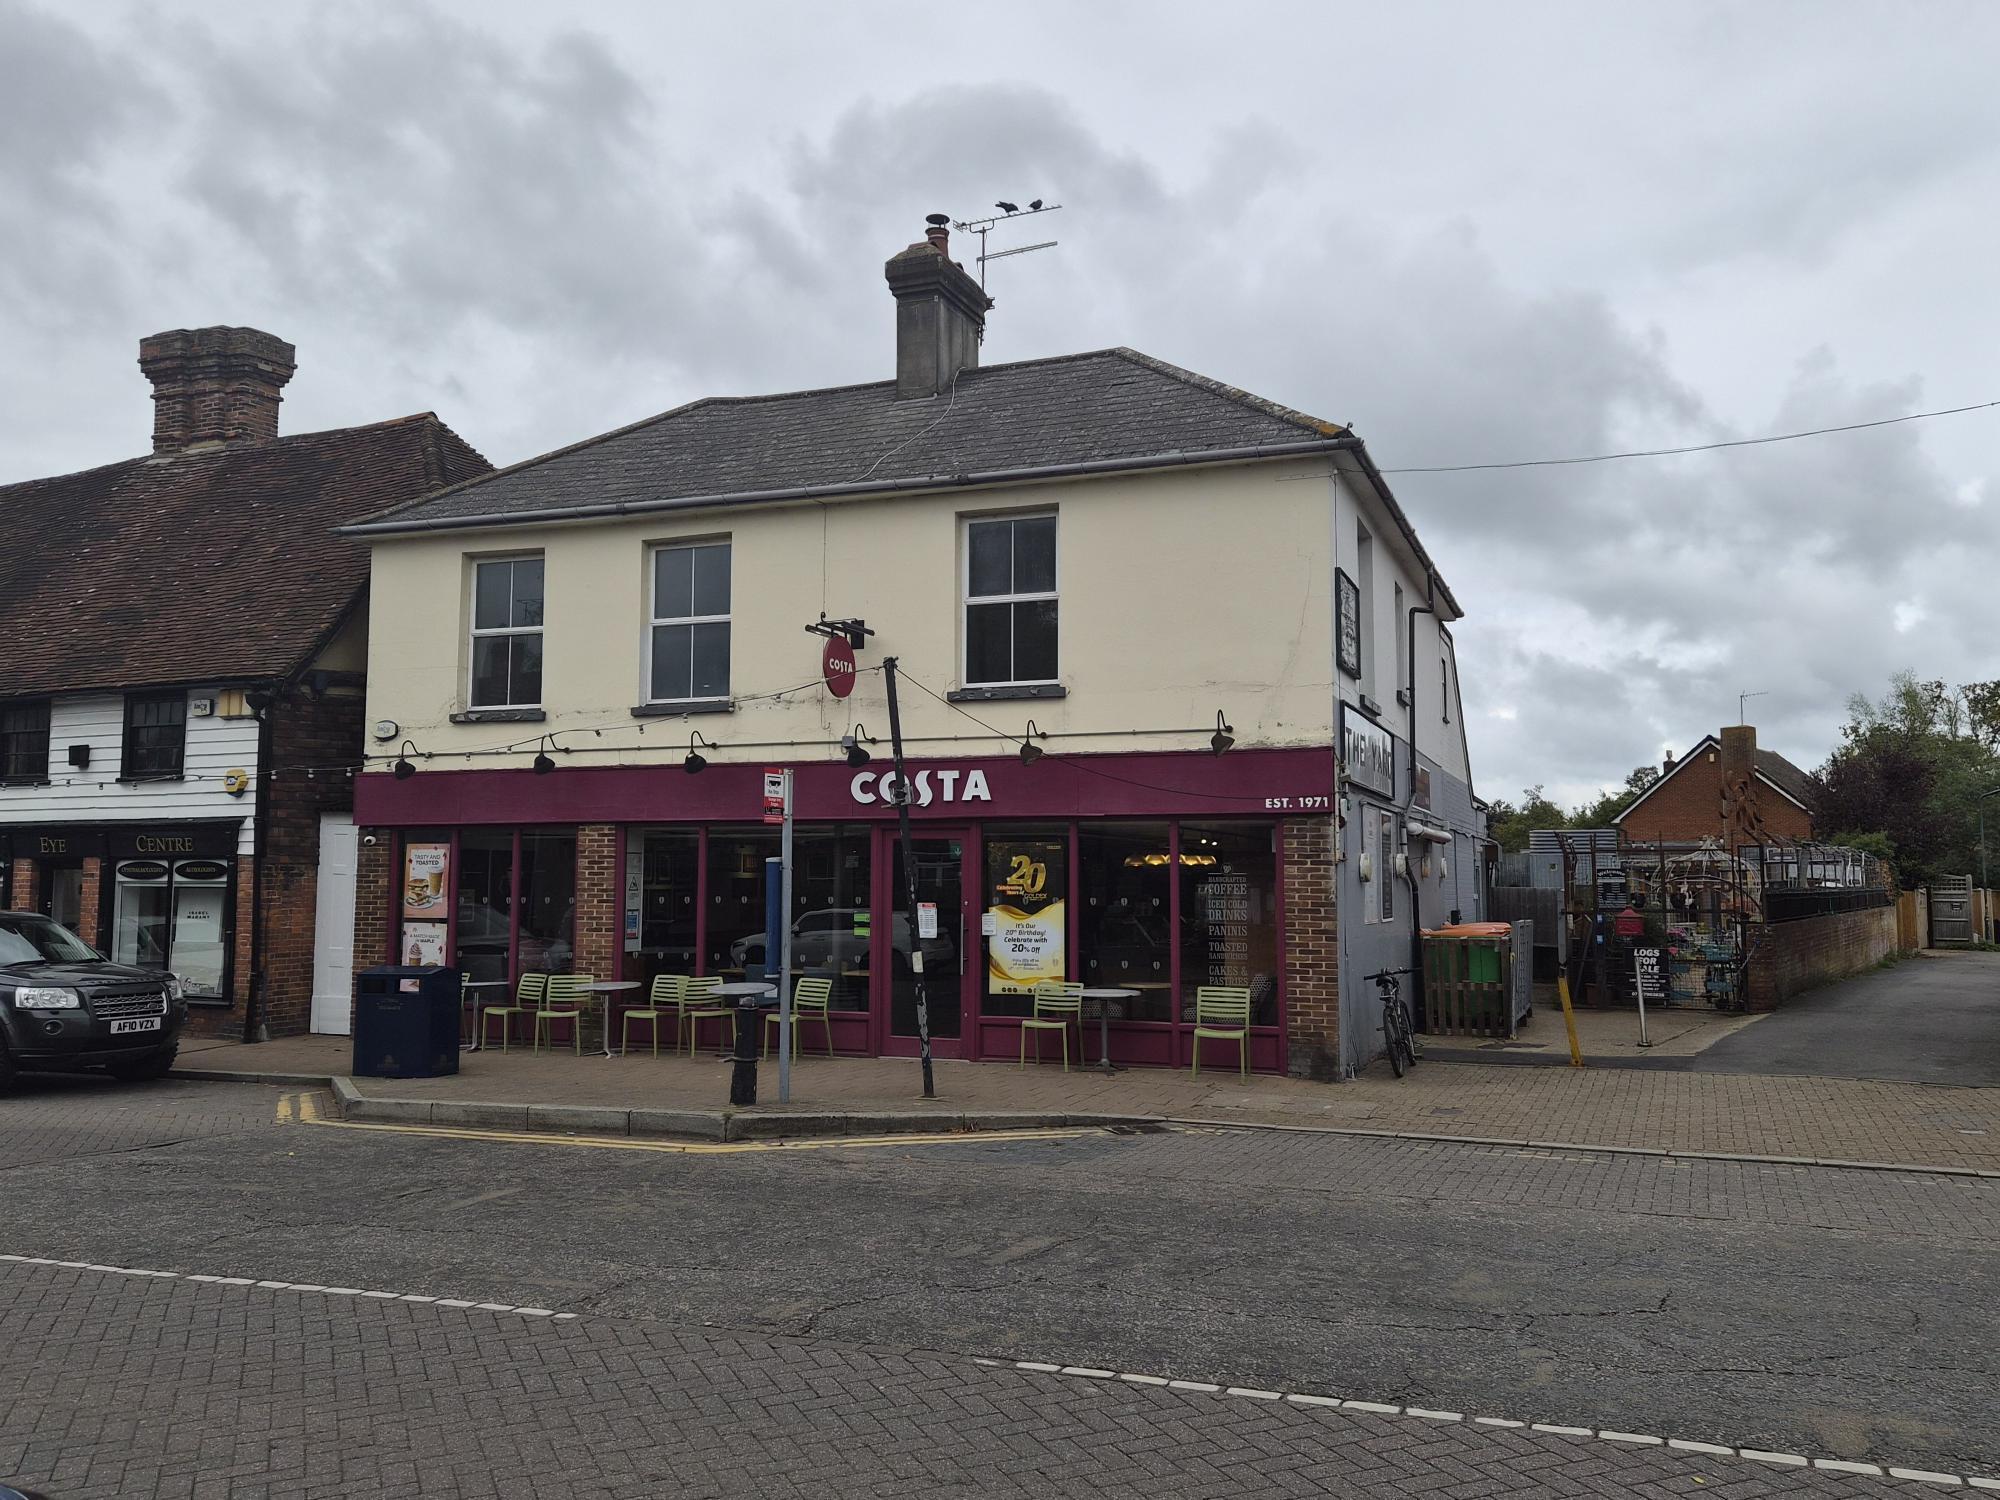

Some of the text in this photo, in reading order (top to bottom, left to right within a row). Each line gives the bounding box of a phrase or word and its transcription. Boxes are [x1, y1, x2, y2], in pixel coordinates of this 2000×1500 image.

[829, 658, 853, 673] COSTA
[1345, 726, 1366, 767] THE
[850, 769, 992, 807] COSTA
[1265, 796, 1328, 809] EST. 1971
[39, 835, 193, 853] EYE CENTRE
[1006, 854, 1047, 893] 20
[1208, 883, 1247, 895] COFFEE
[1208, 899, 1248, 909] ICED COLD
[1208, 909, 1248, 921] DRINKS
[1018, 929, 1047, 938] Birthday!
[1208, 925, 1248, 937] PANINIS
[1011, 943, 1030, 953] 20%
[1208, 941, 1248, 952] TOASTED
[1633, 948, 1660, 957] LOGS
[1208, 965, 1239, 976] CAKES
[1637, 965, 1660, 973] ALE
[1209, 976, 1249, 986] PASTRIES
[117, 1019, 155, 1032] AF10 VZX
